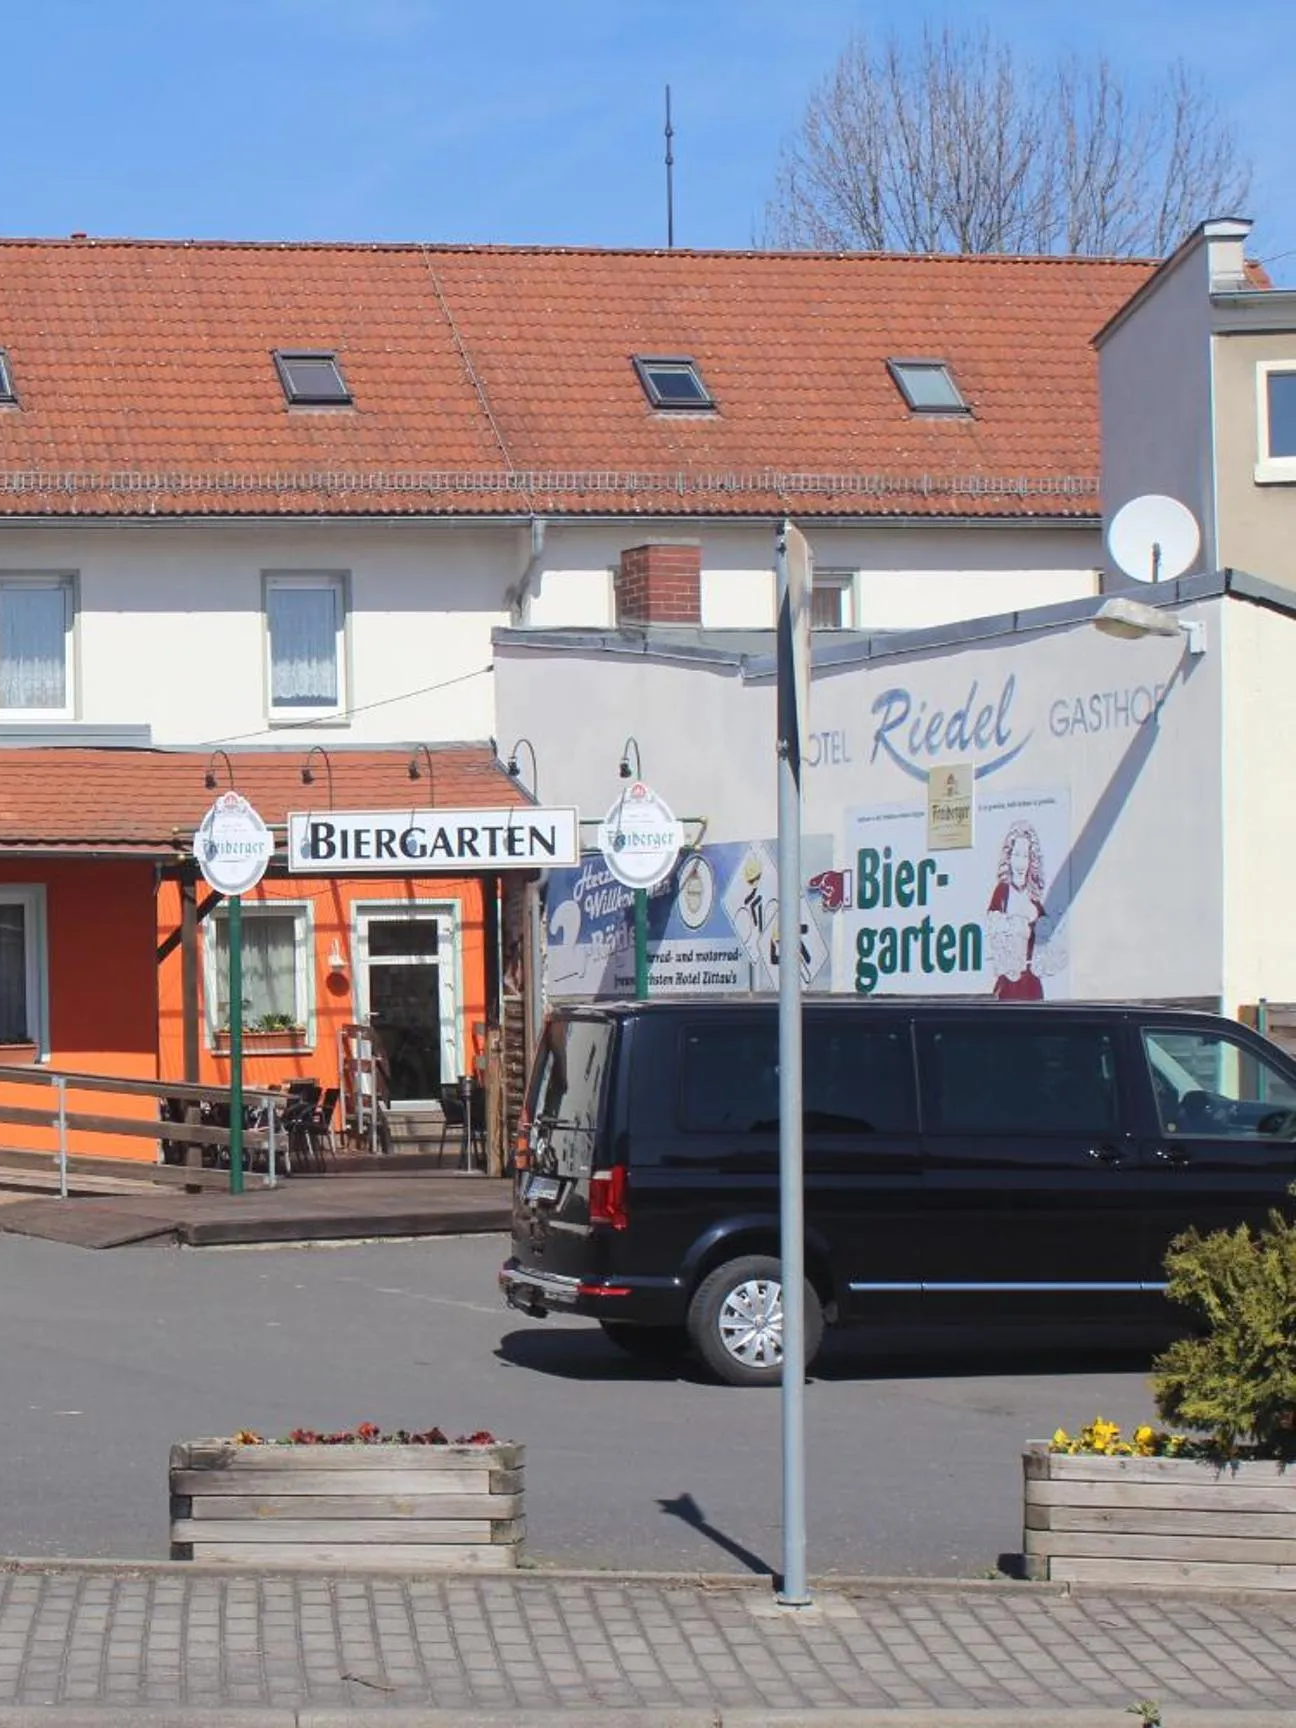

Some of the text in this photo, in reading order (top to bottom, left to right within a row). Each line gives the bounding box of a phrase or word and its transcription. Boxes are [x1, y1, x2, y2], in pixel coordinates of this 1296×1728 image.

[804, 733, 853, 767] OTEL
[870, 673, 1018, 763] Riedel
[310, 820, 556, 860] BIERGARTEN
[857, 846, 949, 909] Bier-
[855, 915, 983, 994] garten
